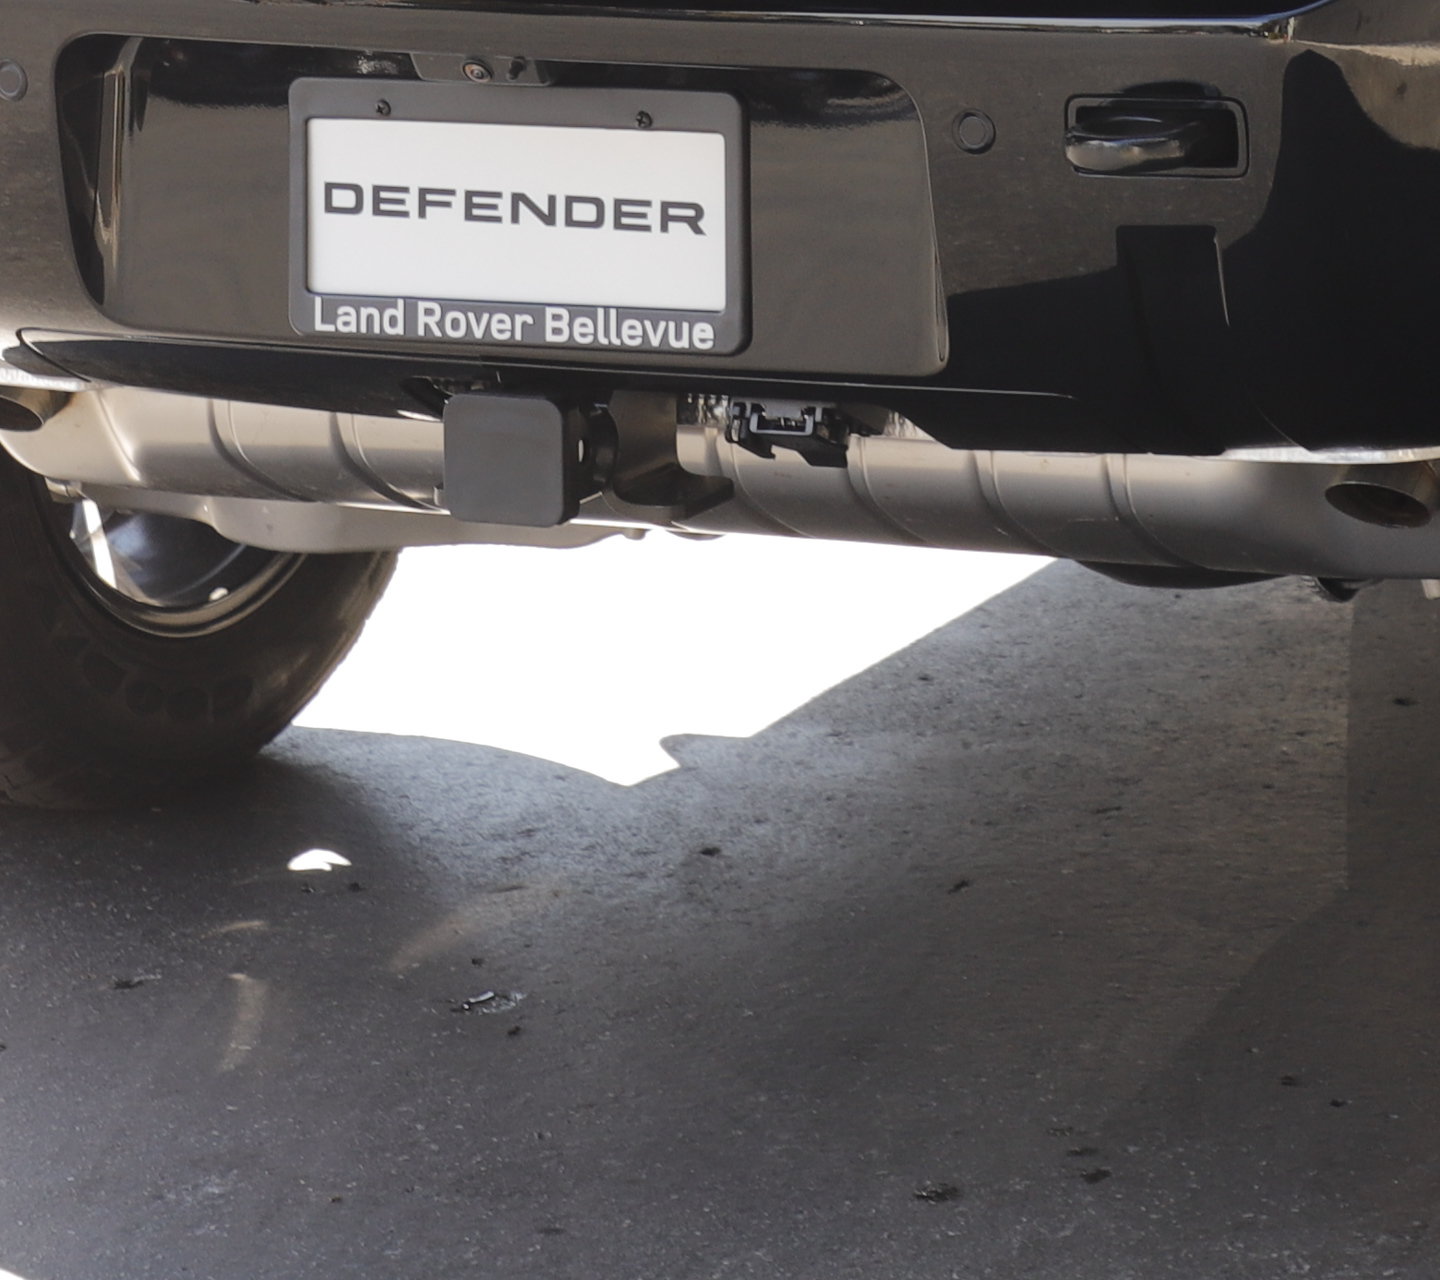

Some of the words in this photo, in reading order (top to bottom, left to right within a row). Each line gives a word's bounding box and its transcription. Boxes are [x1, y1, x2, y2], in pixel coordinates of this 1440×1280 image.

[323, 181, 707, 237] DEFENDER
[313, 296, 405, 335] Land
[417, 301, 534, 341] Rover
[545, 307, 715, 350] Bellevue
